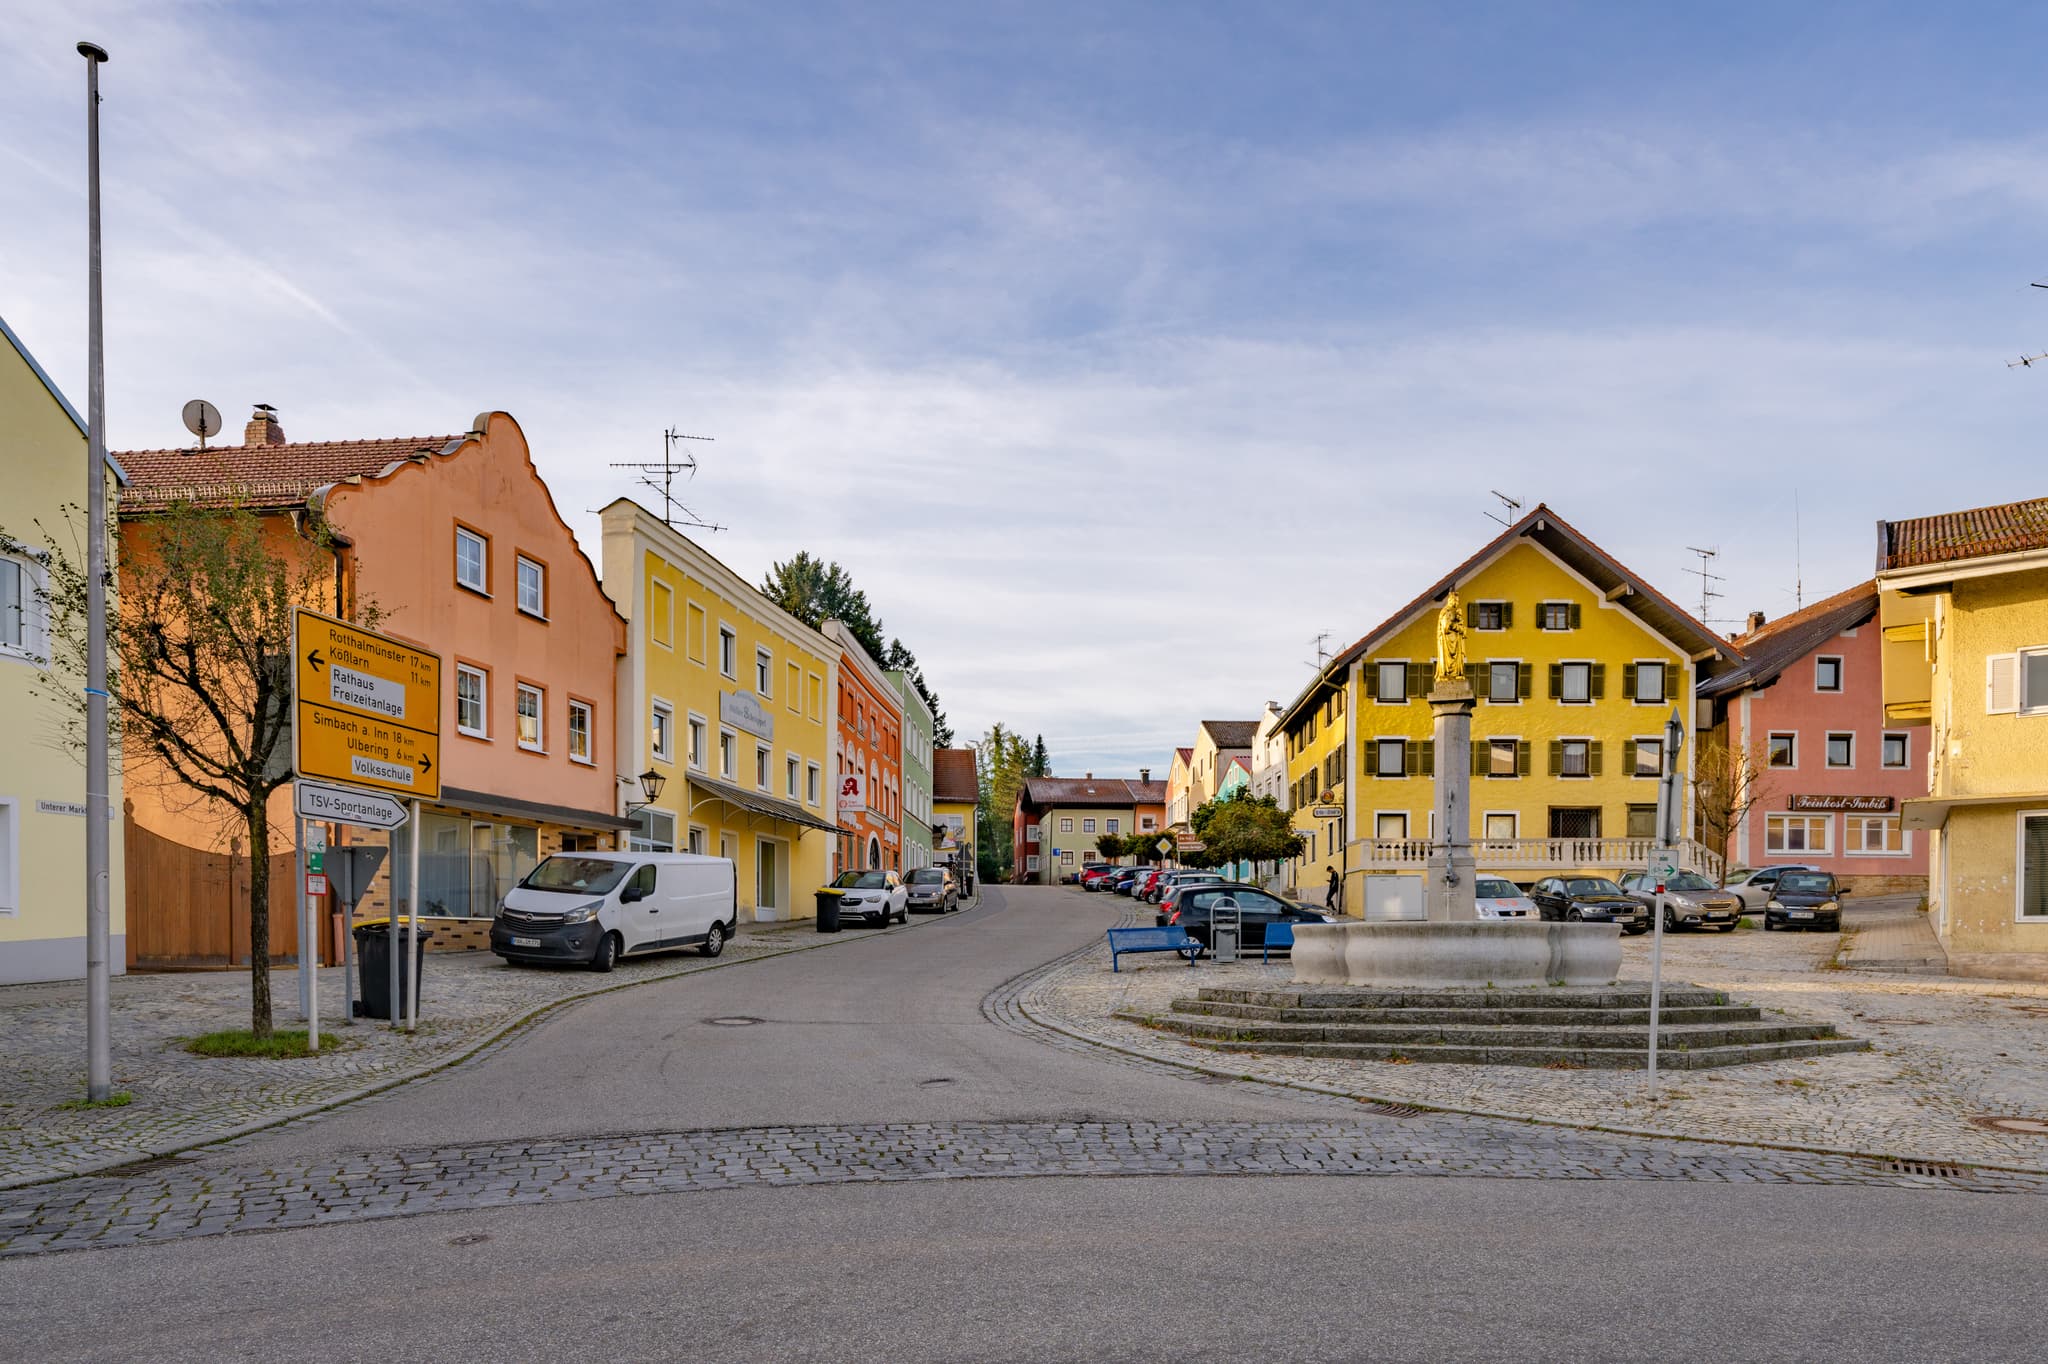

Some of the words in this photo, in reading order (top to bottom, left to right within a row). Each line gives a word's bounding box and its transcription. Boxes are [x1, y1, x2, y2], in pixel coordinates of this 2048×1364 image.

[329, 628, 406, 664] Rotthalmünster
[410, 655, 420, 667] 17
[420, 662, 432, 672] km
[329, 646, 370, 669] Kößlarn
[411, 671, 419, 683] 11
[420, 677, 431, 688] km
[333, 668, 375, 691] Rathaus
[333, 686, 403, 716] Freizeitanlage
[313, 712, 358, 733] Simbach
[361, 727, 371, 737] a.
[374, 727, 389, 741] Inn
[393, 732, 402, 743] 18
[403, 736, 415, 746] km
[347, 736, 389, 759] Ulbering
[396, 747, 402, 760] 6
[403, 752, 415, 763] km
[354, 759, 411, 782] Volksschule
[40, 801, 66, 812] Unterer
[309, 793, 393, 819] TSV-Sportanlage
